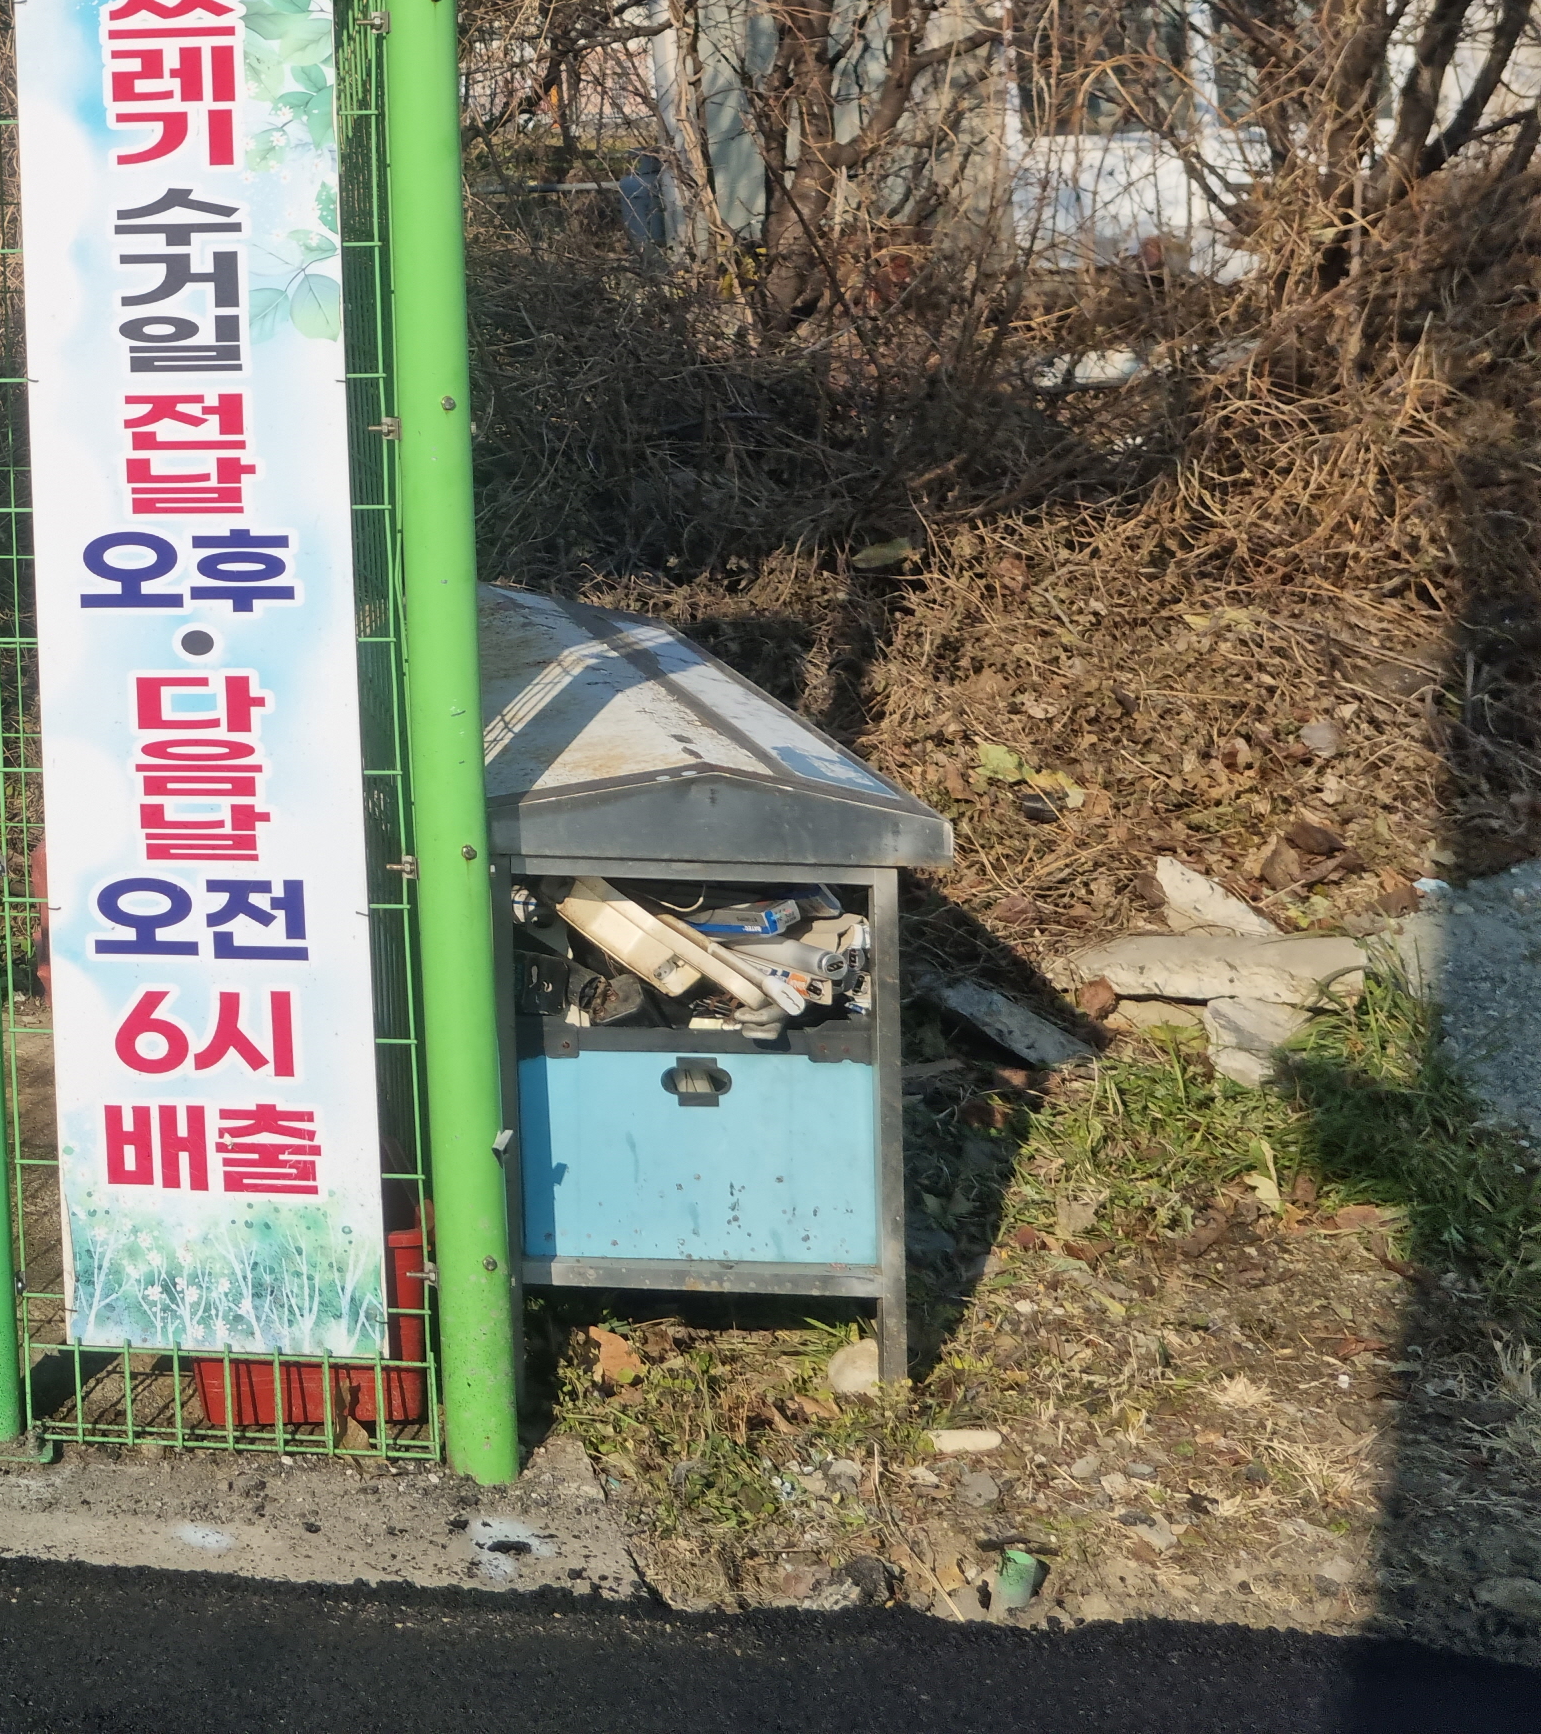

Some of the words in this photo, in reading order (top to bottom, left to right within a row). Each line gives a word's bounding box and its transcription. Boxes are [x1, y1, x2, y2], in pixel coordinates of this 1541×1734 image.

[114, 187, 243, 372] 수거일
[123, 392, 256, 515] 전날
[80, 528, 296, 613] 오후
[135, 674, 270, 862] 다음날
[95, 878, 309, 961] 오전
[114, 989, 295, 1078] 6시
[104, 1102, 323, 1195] 배출
